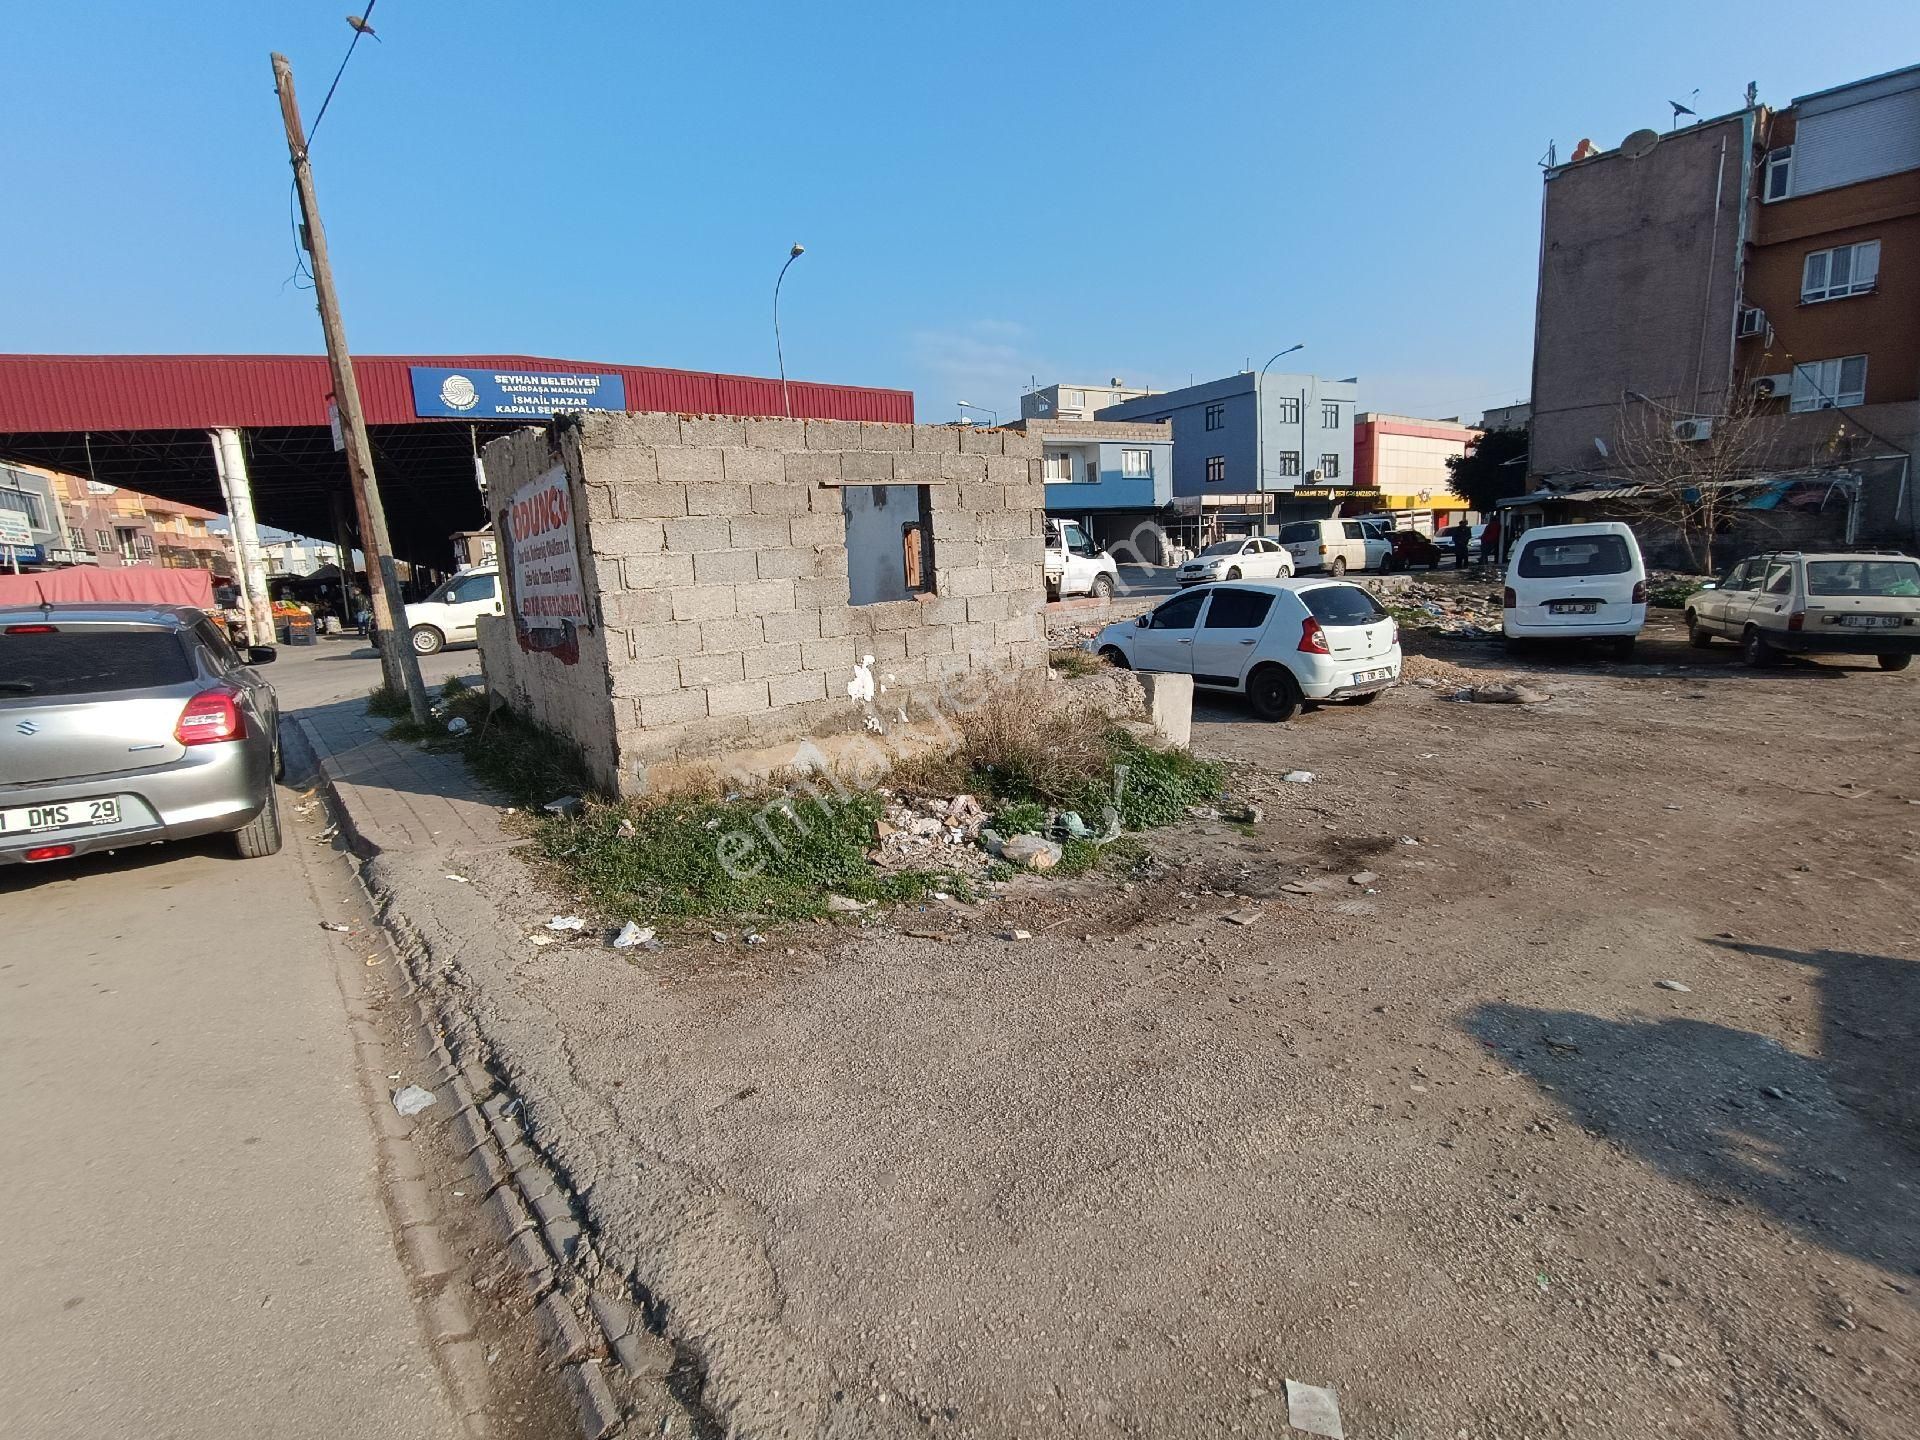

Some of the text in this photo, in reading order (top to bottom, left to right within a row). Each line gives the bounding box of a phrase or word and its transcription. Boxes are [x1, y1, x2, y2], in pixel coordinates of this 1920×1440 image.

[494, 375, 600, 387] SEYHAN BELEDİYESİ
[513, 394, 588, 406] İSMAİL HAZAR
[495, 405, 536, 414] KAPALI
[537, 406, 566, 415] SEMT
[0, 800, 115, 830] 1 DMS 29
